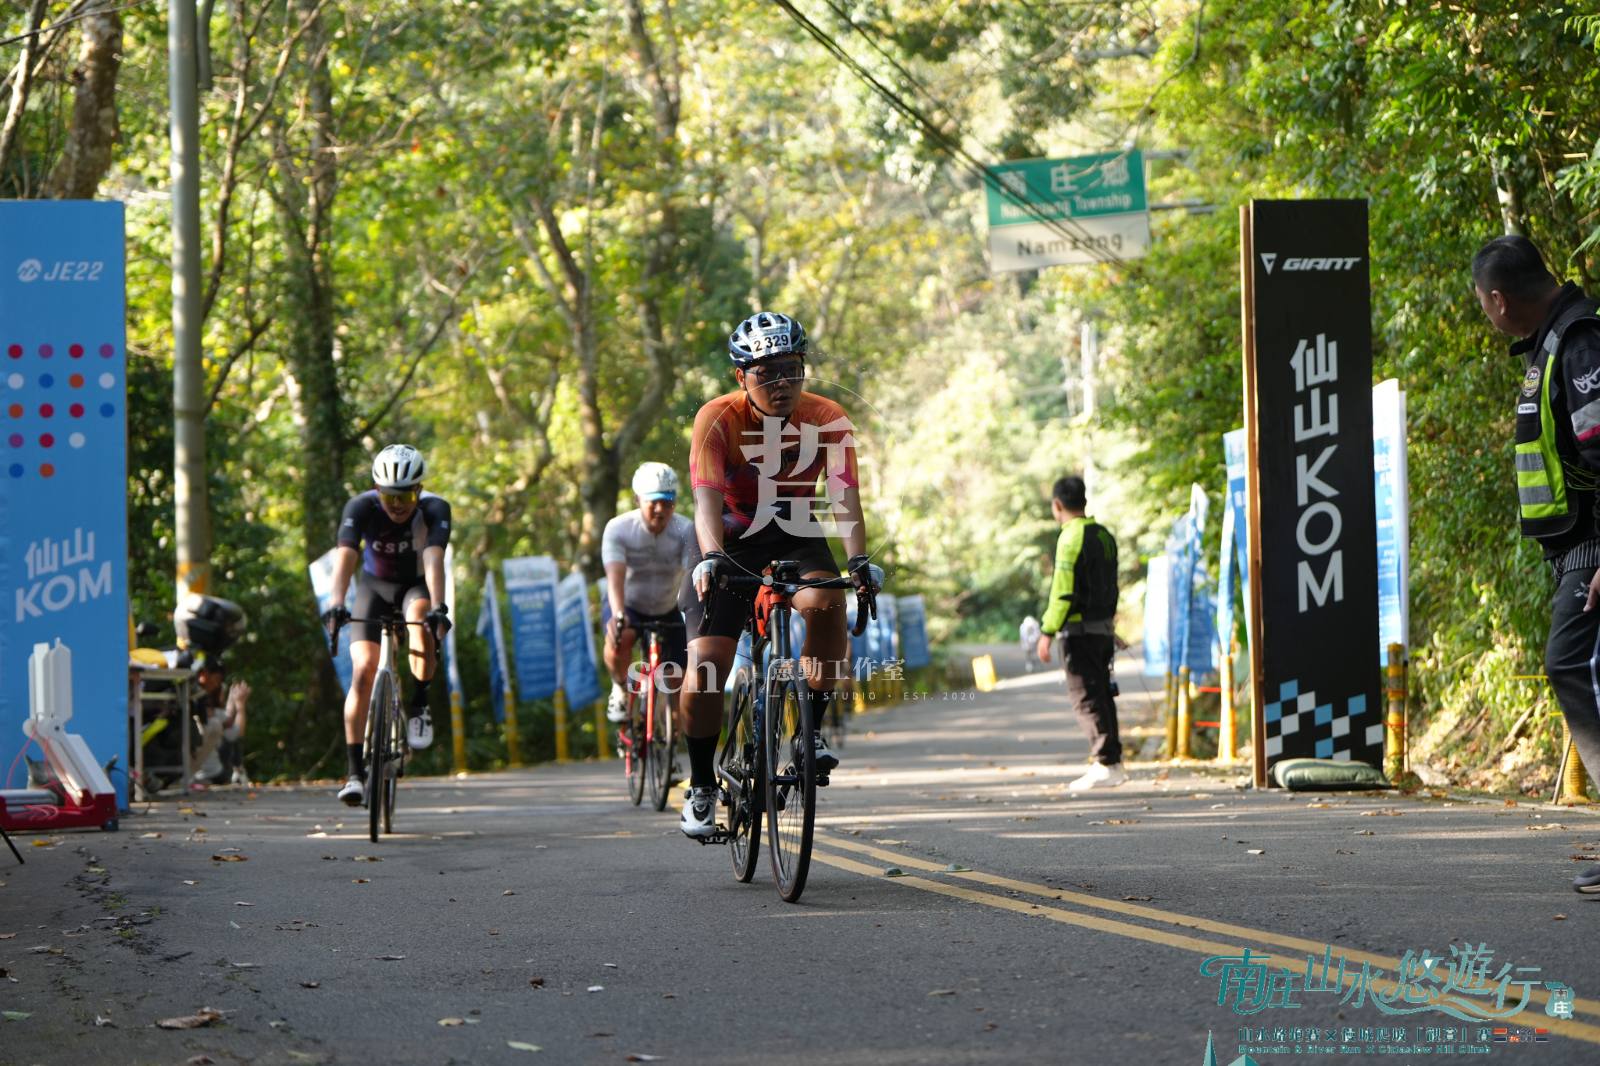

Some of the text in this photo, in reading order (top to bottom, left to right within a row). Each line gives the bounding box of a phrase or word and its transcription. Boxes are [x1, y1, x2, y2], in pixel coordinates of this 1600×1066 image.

[43, 260, 104, 281] JE22
[1282, 257, 1361, 271] GIANT
[754, 334, 789, 352] 2329
[15, 560, 112, 623] KOM
